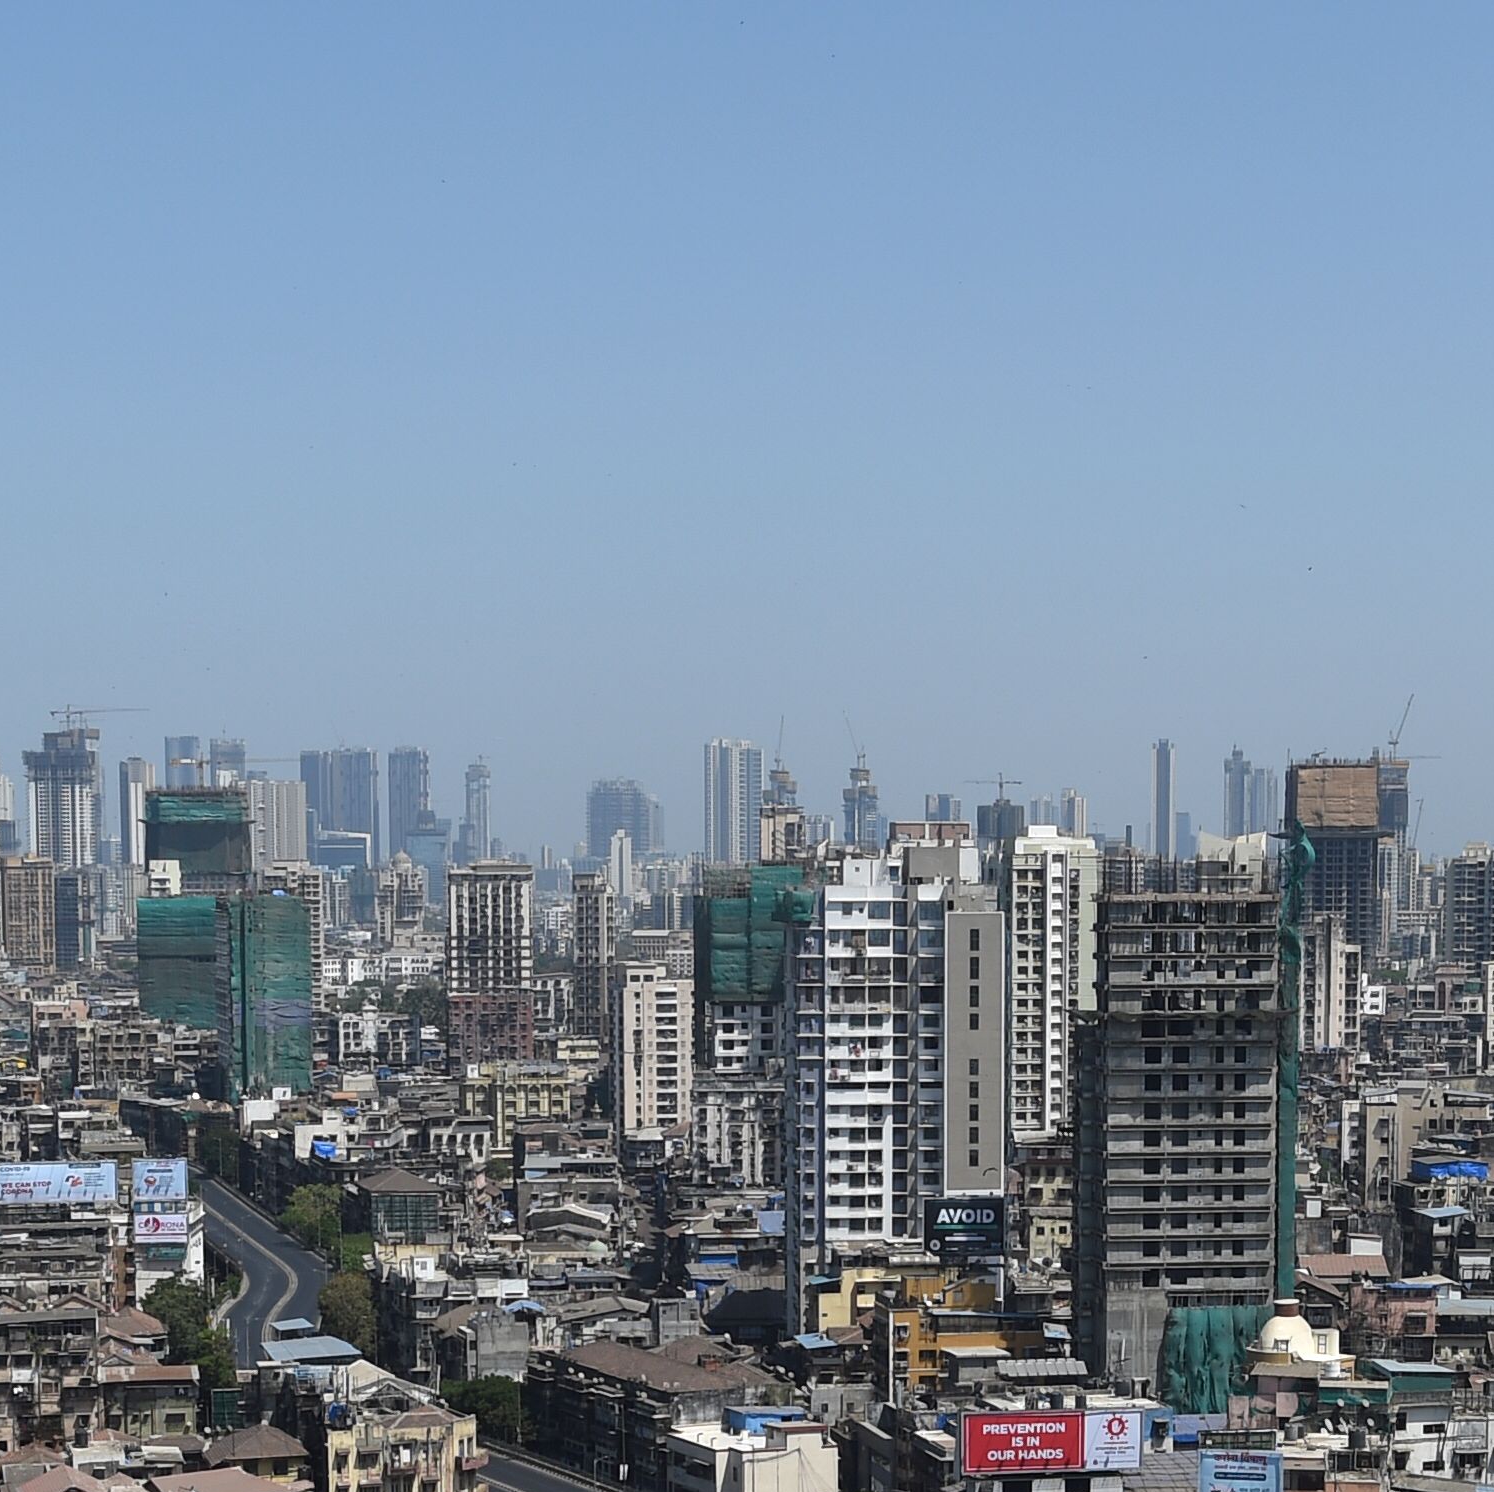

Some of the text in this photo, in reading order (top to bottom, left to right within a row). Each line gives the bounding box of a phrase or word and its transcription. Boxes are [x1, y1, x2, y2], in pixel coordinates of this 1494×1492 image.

[33, 1180, 52, 1188] STOP
[936, 1208, 995, 1224] AVOID
[982, 1422, 1066, 1435] PREVENTION
[1011, 1436, 1040, 1447] IS IN
[987, 1448, 1064, 1461] OUR HANDS
